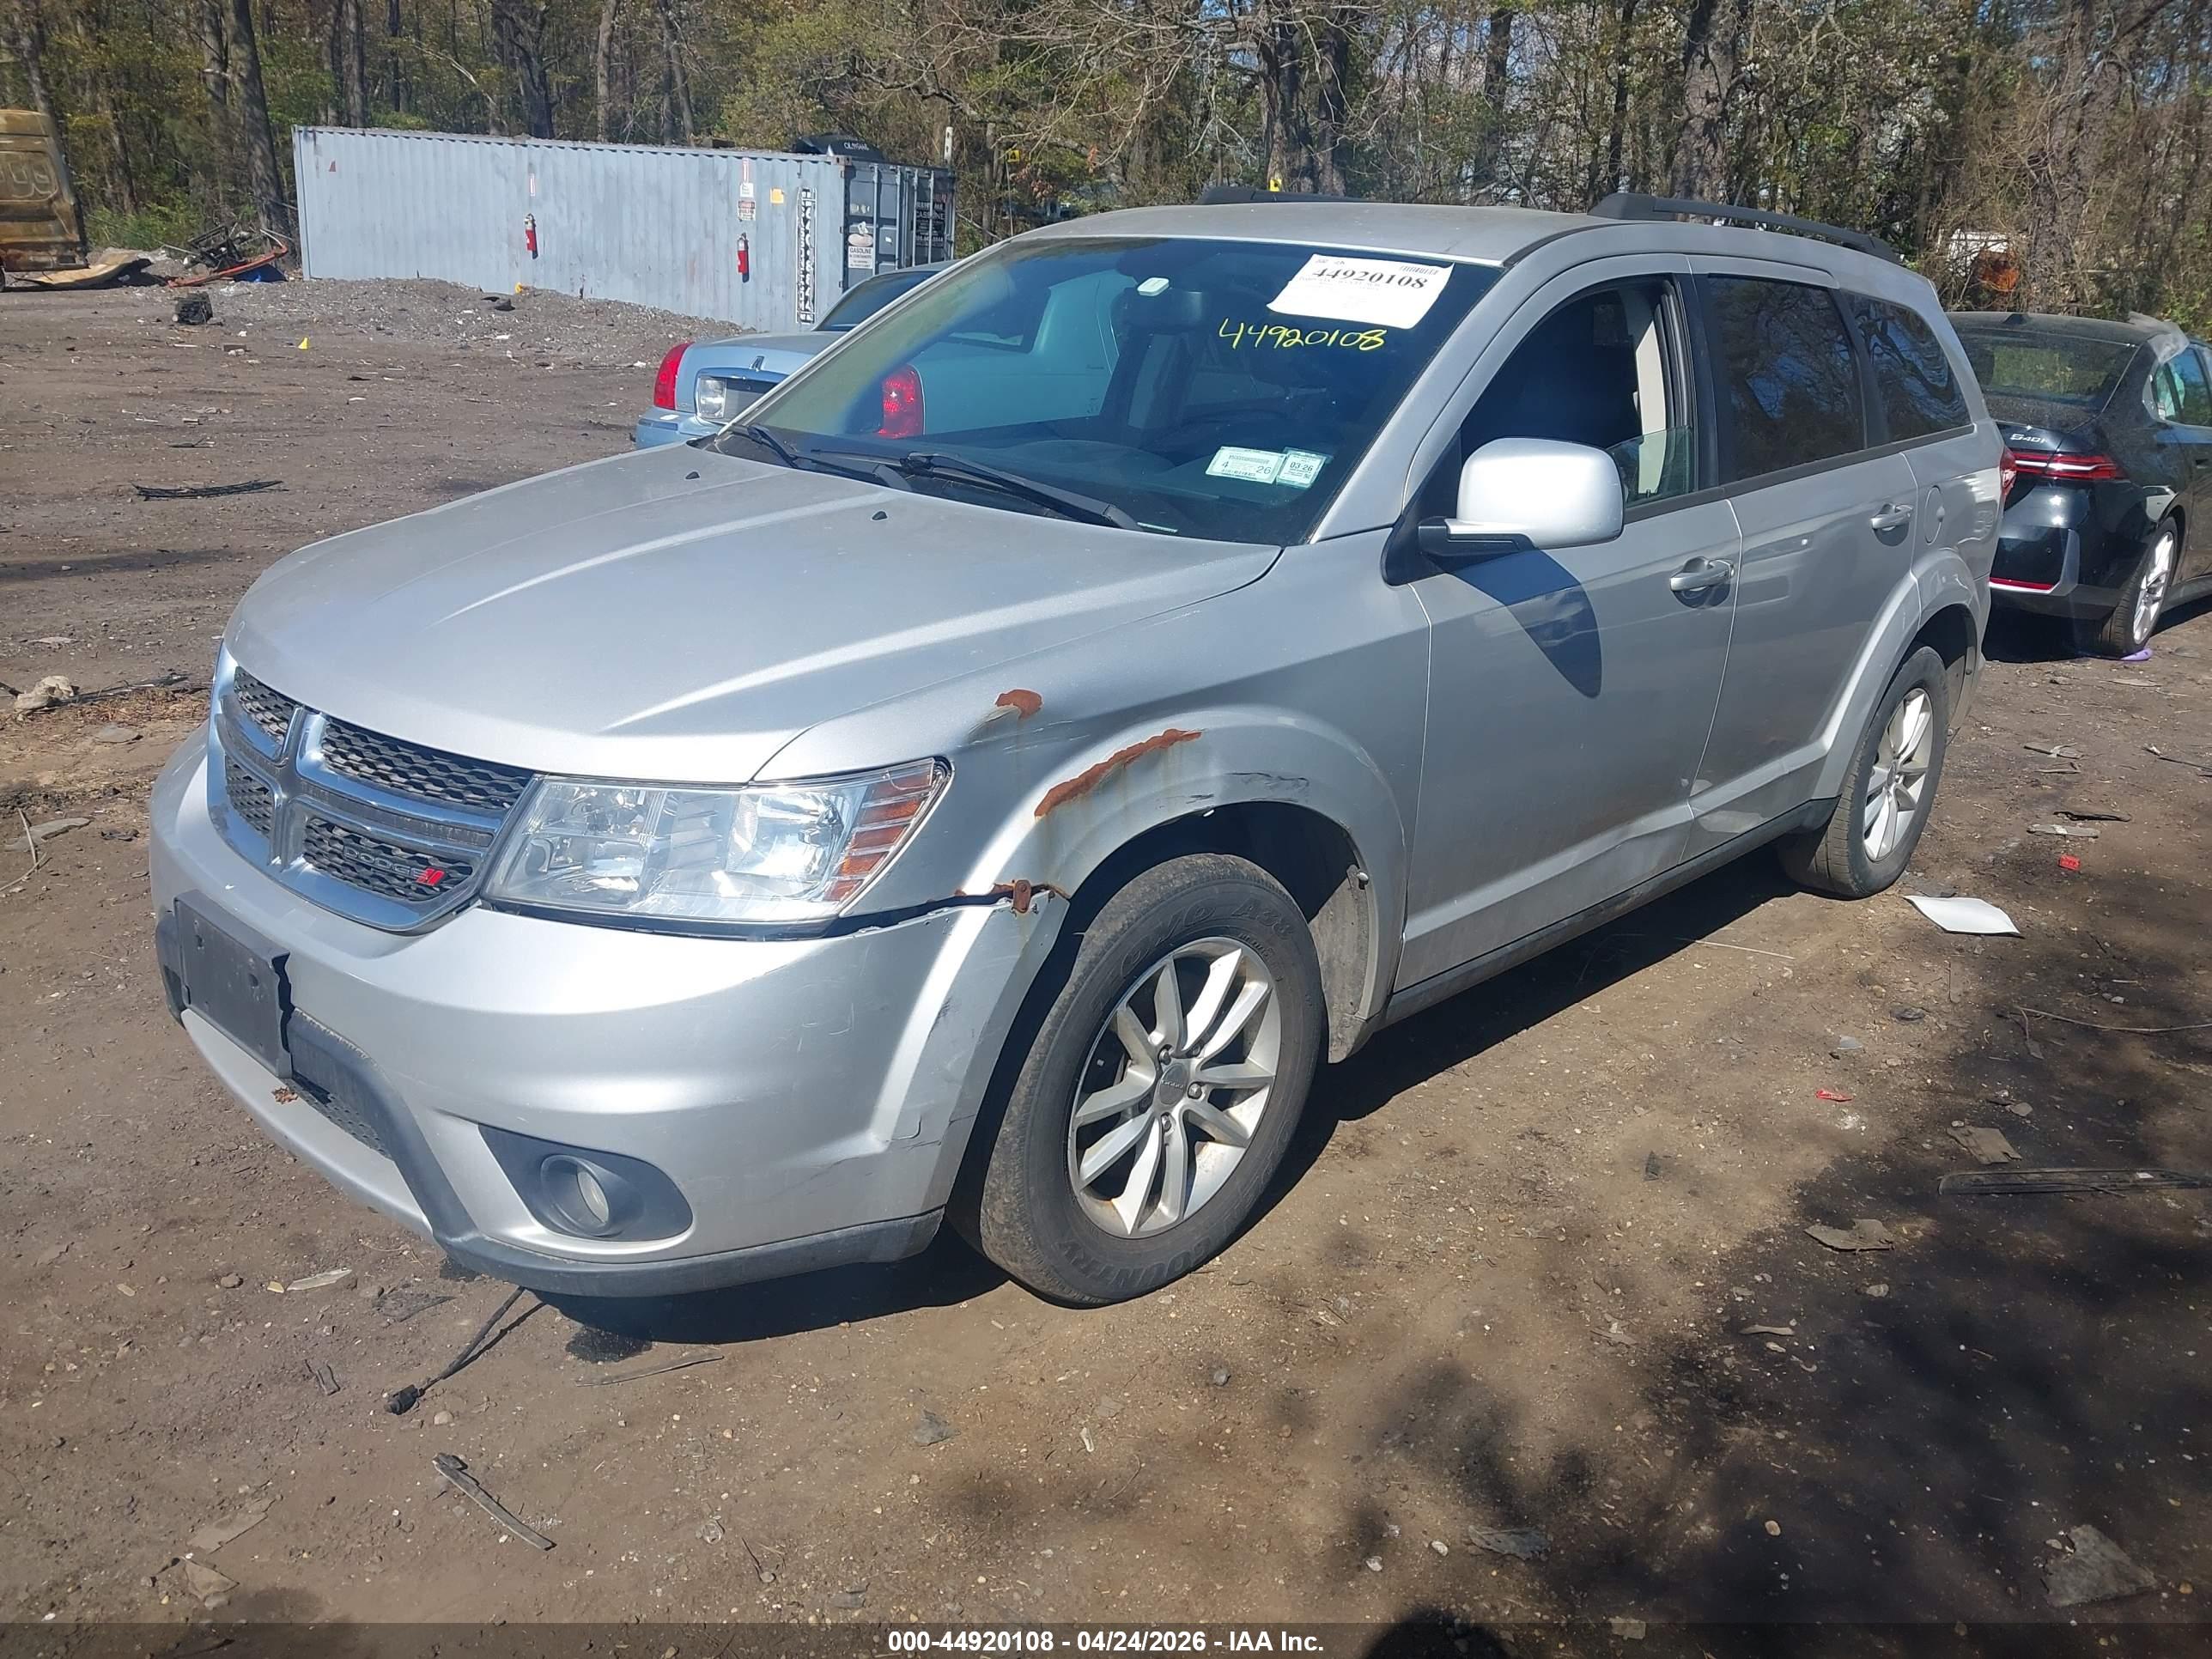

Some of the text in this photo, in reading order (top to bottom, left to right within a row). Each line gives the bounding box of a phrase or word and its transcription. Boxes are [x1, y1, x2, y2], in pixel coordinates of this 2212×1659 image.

[1312, 267, 1428, 289] 44920108
[1218, 318, 1388, 350] 44920108
[1255, 465, 1272, 475] 26
[343, 845, 428, 881] DODGE
